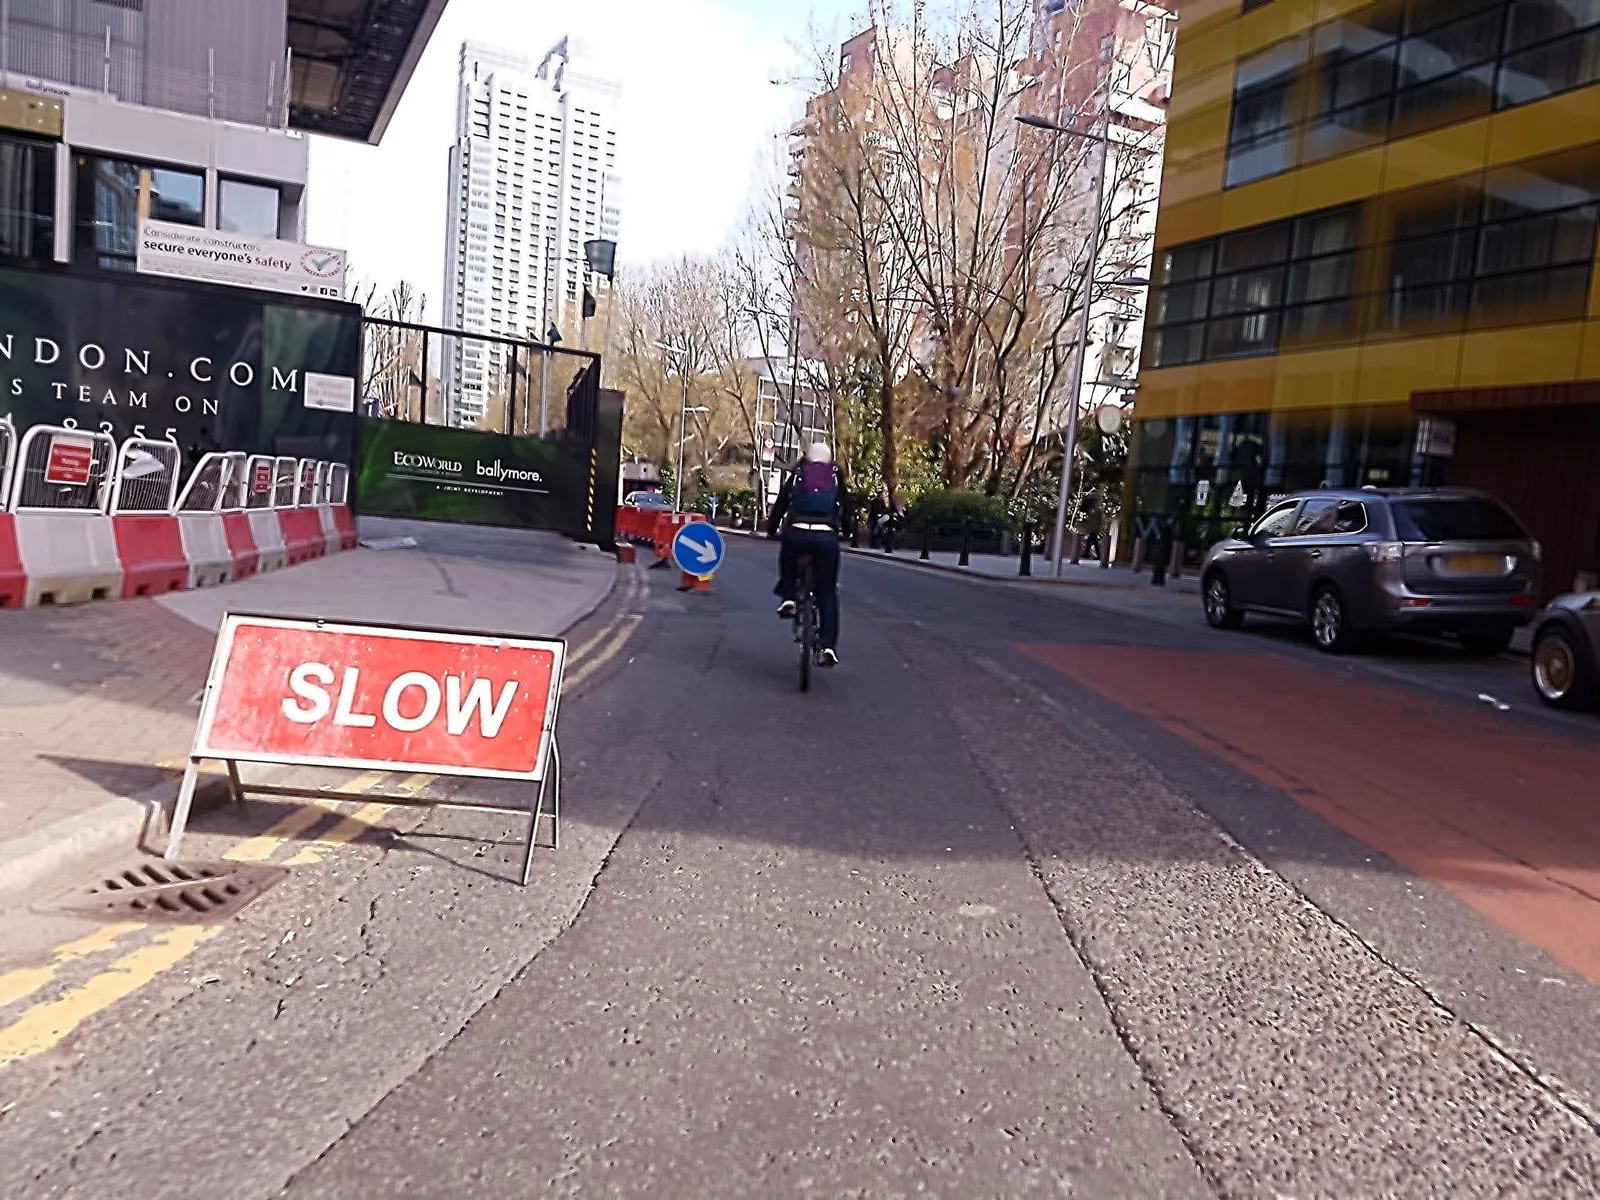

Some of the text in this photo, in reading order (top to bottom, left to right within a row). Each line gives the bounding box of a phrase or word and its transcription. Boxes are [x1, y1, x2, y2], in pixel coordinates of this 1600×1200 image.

[143, 240, 185, 254] secure
[187, 246, 252, 264] everyone's
[254, 256, 292, 272] safety
[51, 382, 148, 408] TEAM
[174, 395, 219, 416] ON
[281, 661, 519, 739] SLOW
